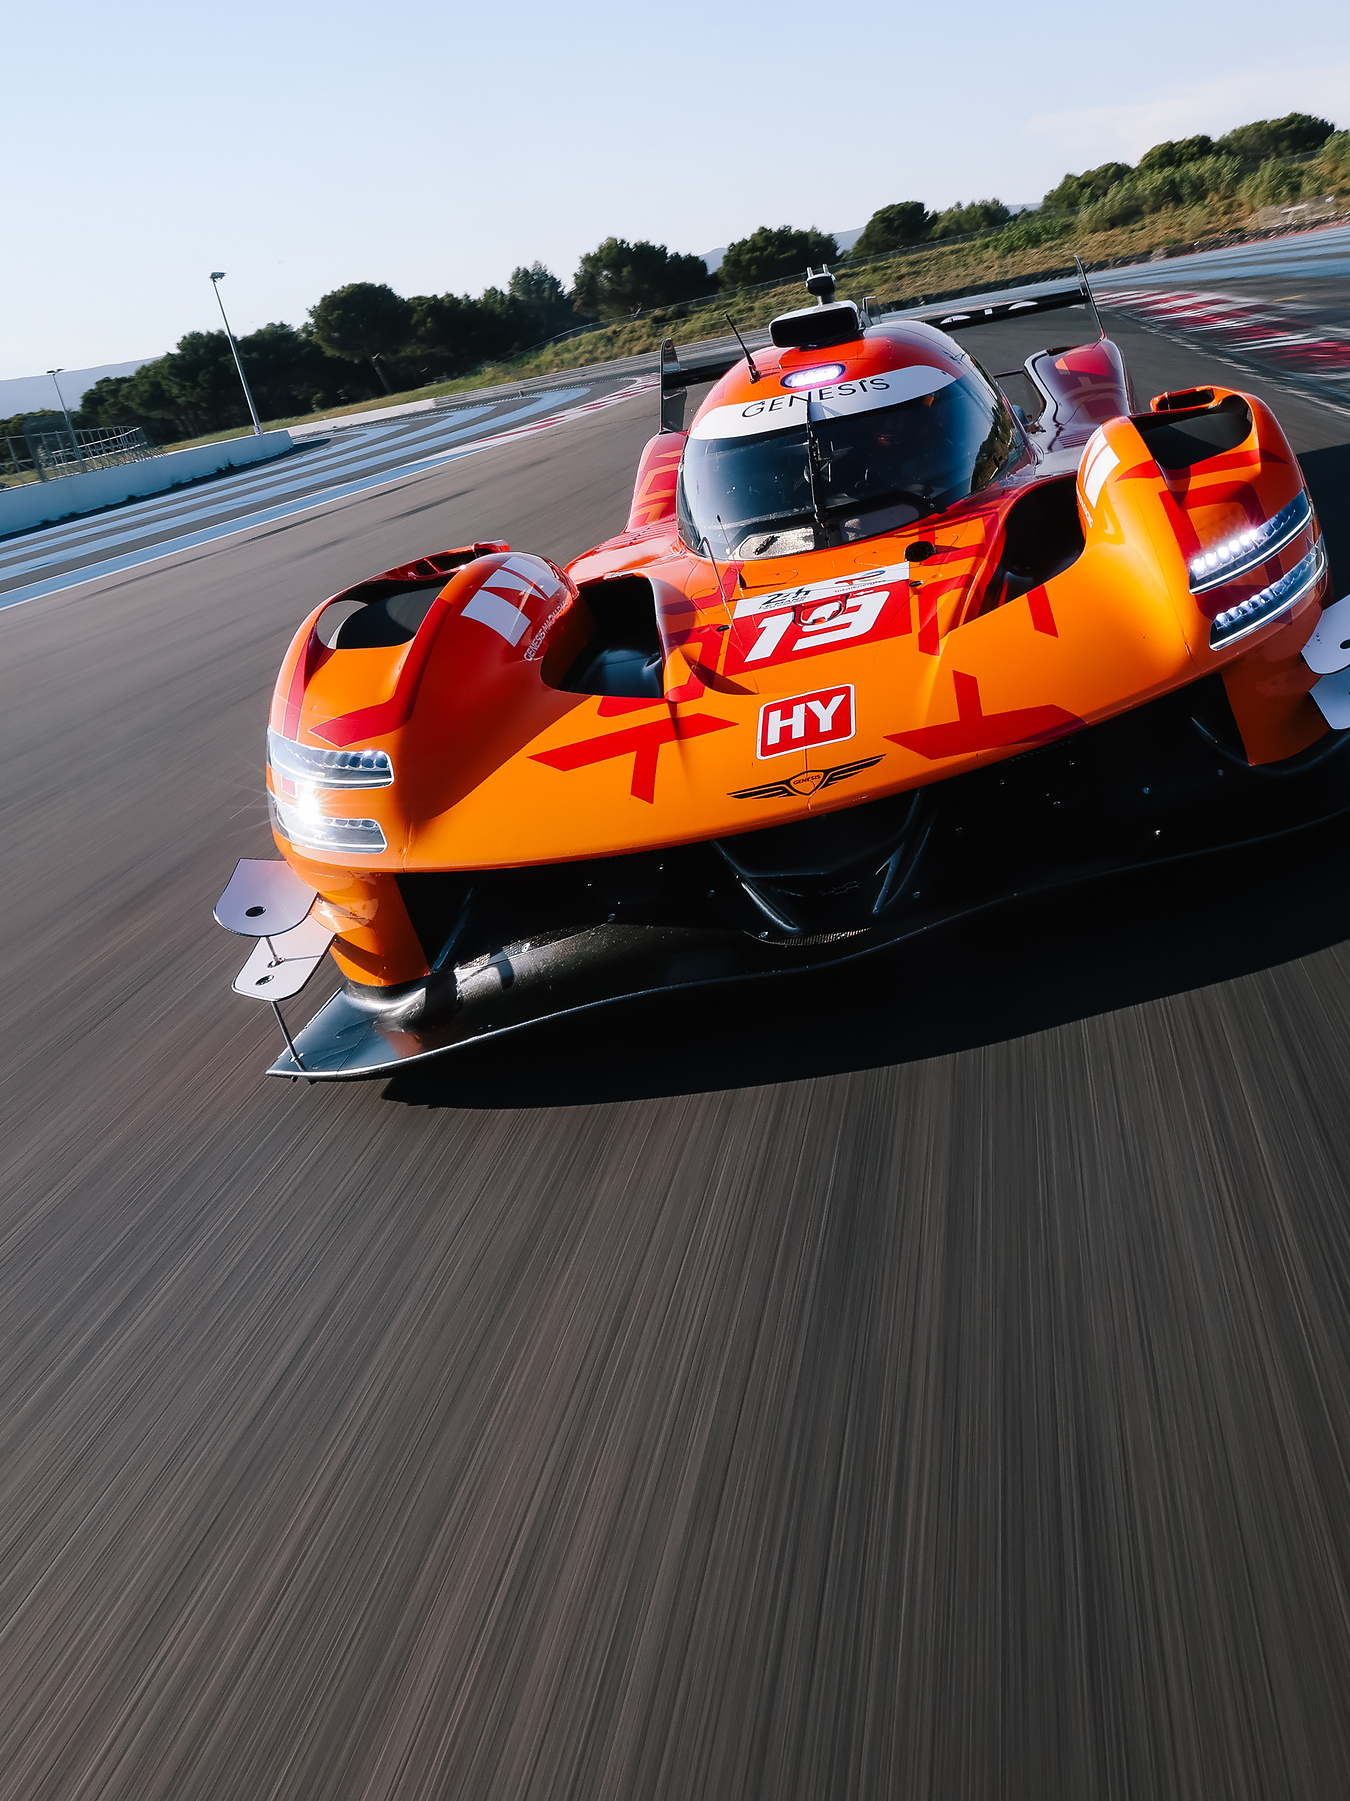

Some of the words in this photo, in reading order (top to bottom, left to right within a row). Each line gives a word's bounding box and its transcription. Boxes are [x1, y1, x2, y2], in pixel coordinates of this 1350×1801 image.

[742, 378, 890, 418] GENESIS
[523, 628, 546, 661] GENESIS
[744, 591, 890, 663] 19
[767, 694, 846, 746] HY
[793, 774, 821, 785] GENESIS
